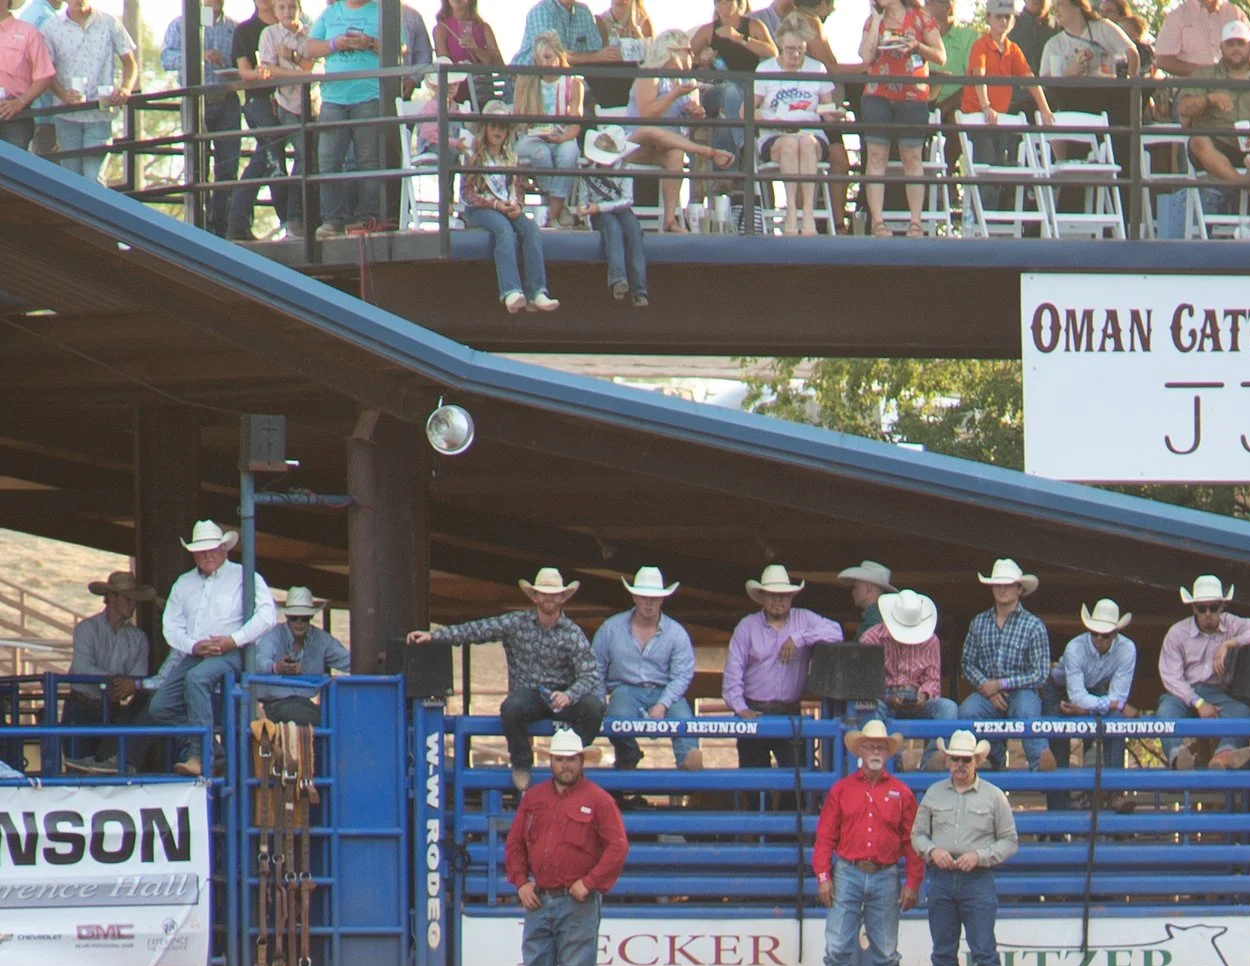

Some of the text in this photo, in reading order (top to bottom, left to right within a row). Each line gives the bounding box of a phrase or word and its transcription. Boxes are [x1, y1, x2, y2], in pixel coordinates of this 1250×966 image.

[1030, 302, 1153, 353] OMAN
[611, 720, 680, 733] COWBOY
[686, 721, 758, 734] REUNION
[973, 721, 1175, 733] TEXAS COWBOY REUNION
[0, 806, 191, 866] NSON
[426, 732, 441, 949] W-W RODEO
[108, 874, 189, 898] Hall
[17, 933, 62, 941] CHEVROLET
[76, 923, 135, 941] GMC
